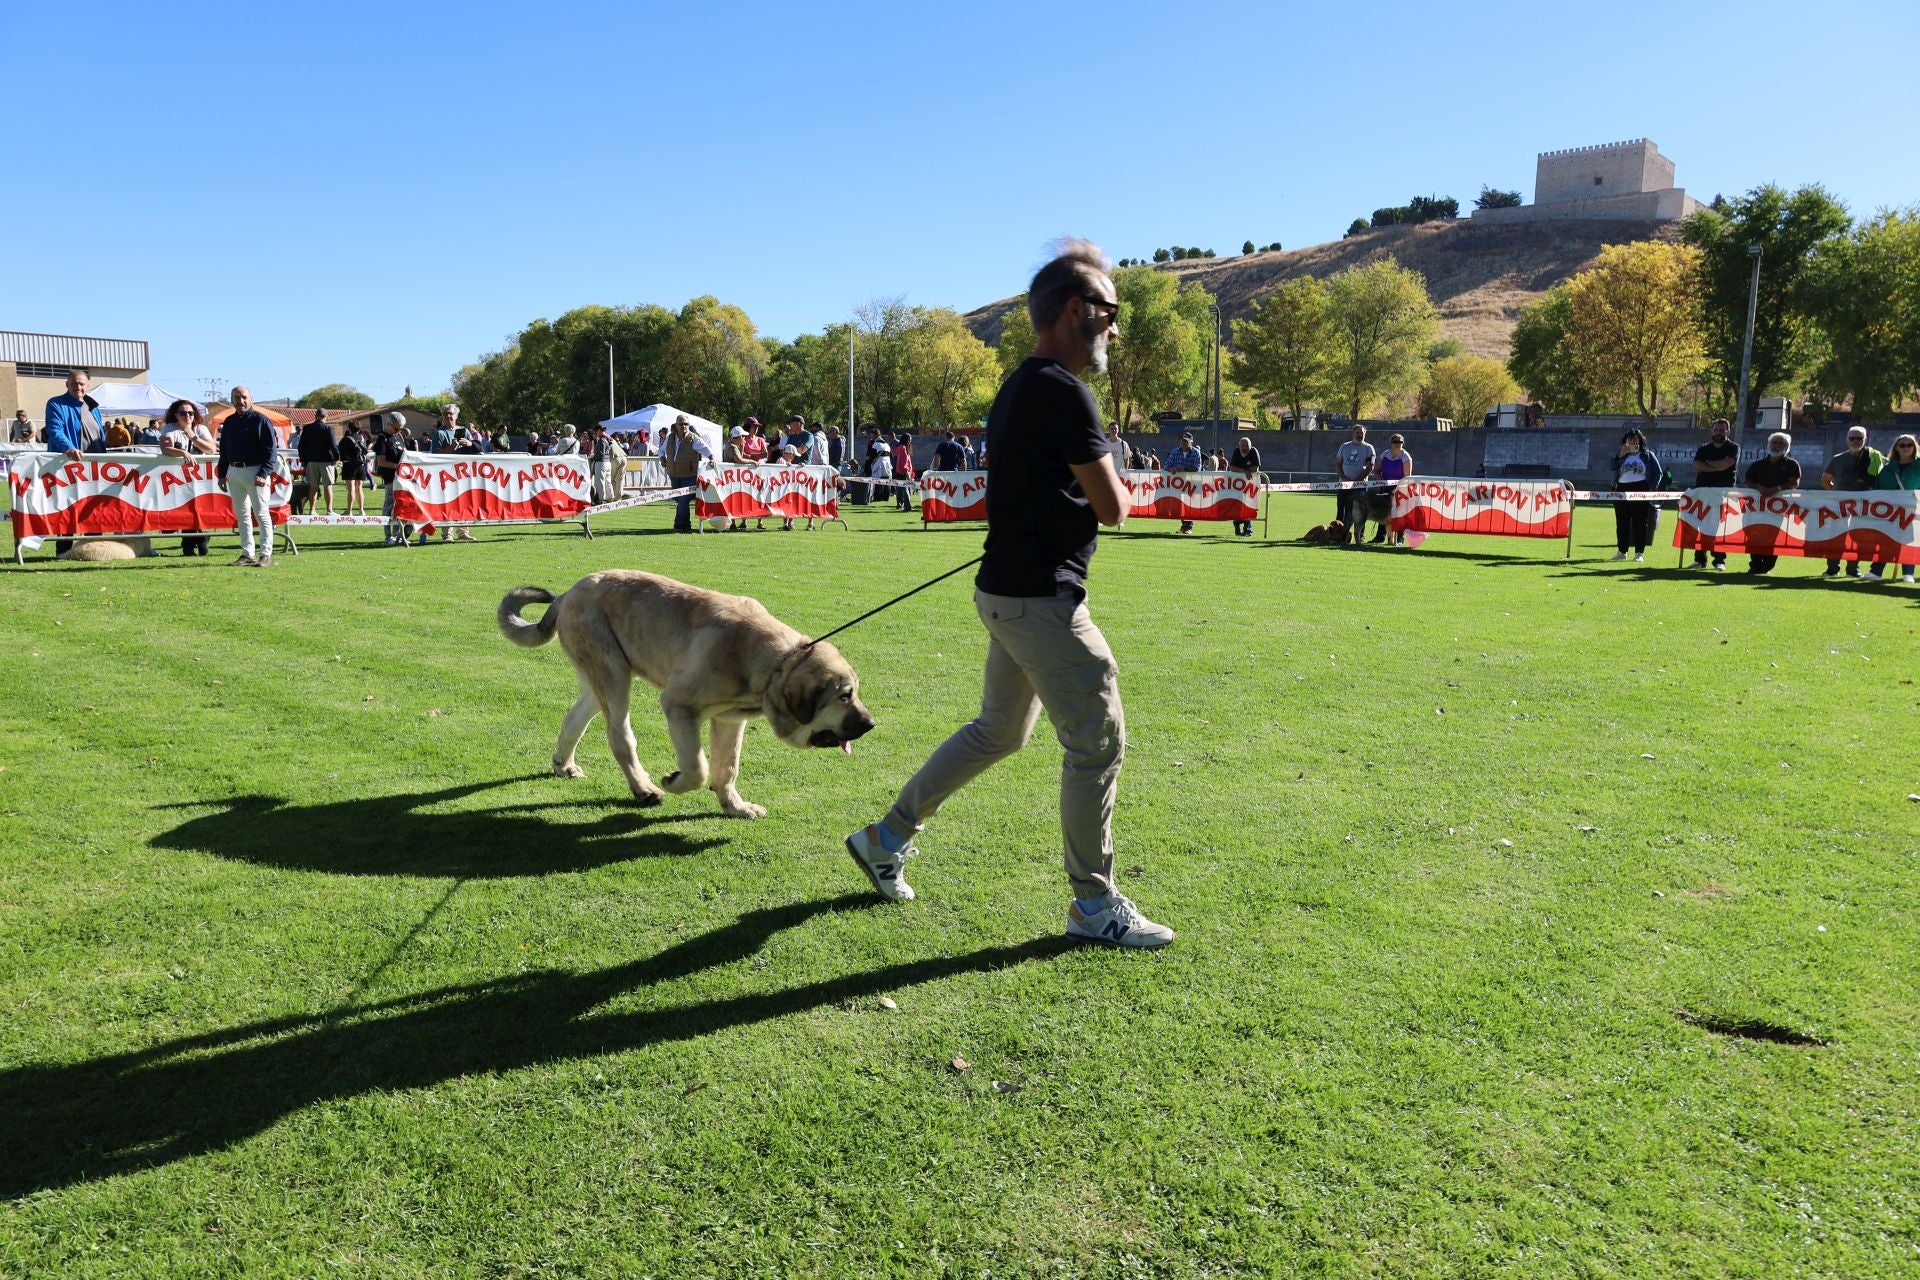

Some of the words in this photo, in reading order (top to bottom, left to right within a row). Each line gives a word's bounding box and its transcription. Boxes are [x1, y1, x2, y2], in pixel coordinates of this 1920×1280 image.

[41, 461, 151, 498] ARION
[396, 462, 432, 490] ON
[439, 461, 511, 490] ARION
[518, 462, 585, 490] ARION
[715, 469, 766, 492] ARION
[769, 470, 818, 493] ARION
[963, 476, 986, 498] AR
[1141, 476, 1196, 498] ARION
[1202, 476, 1259, 499] ARION
[1393, 482, 1456, 508] ARION
[1461, 484, 1528, 510] ARION
[1719, 495, 1810, 526] ARION
[1818, 498, 1916, 531] ARION
[1102, 919, 1130, 940] N
